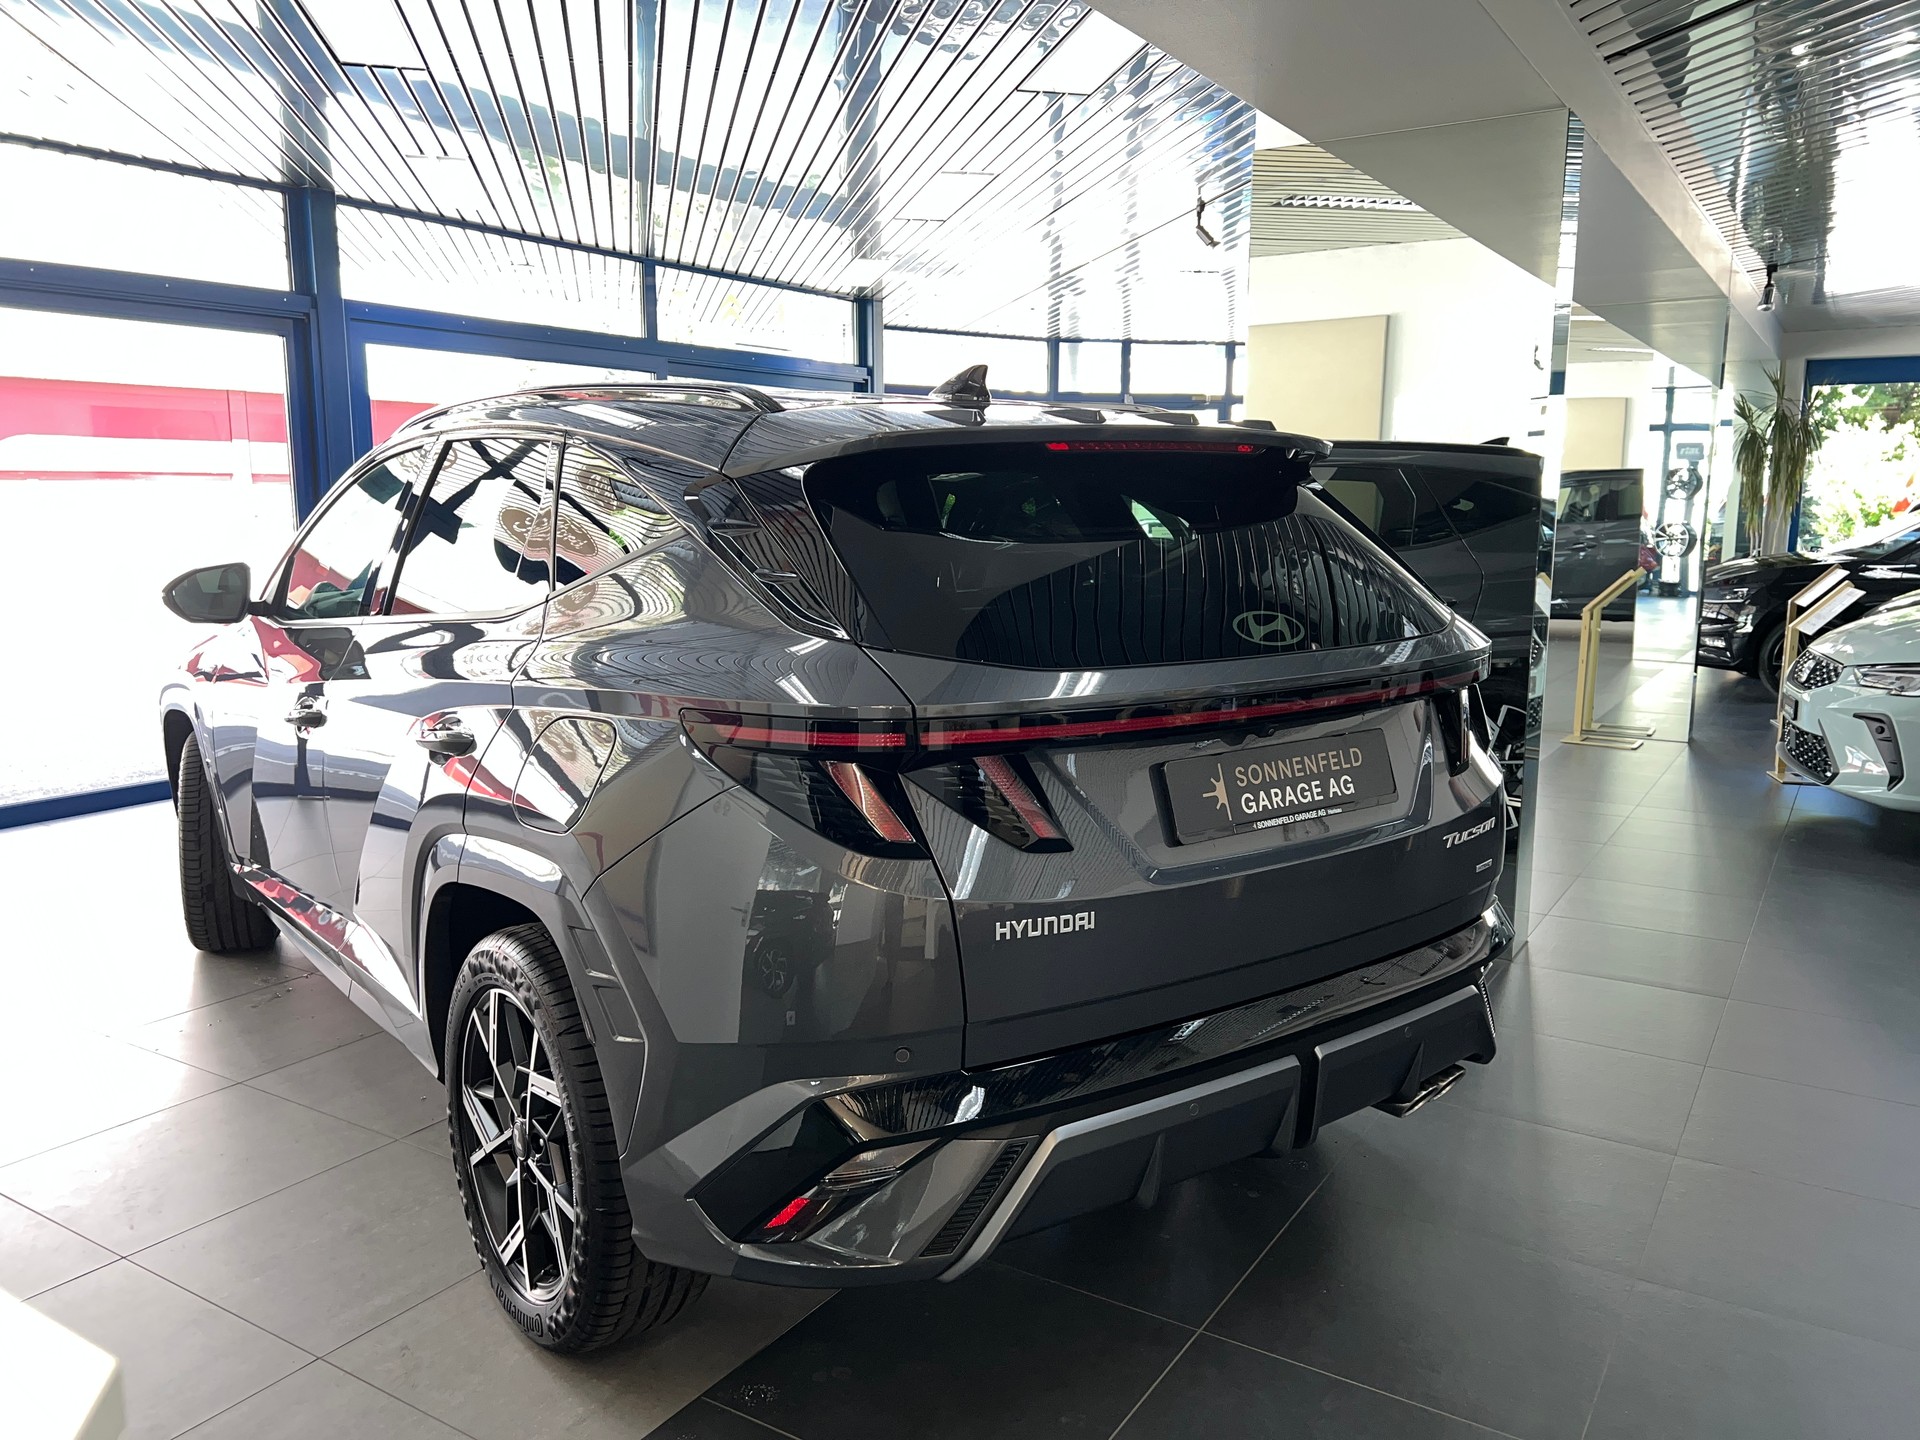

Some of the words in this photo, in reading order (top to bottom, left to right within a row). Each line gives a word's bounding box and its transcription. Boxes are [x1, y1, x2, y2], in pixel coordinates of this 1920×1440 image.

[1235, 747, 1363, 787] SONNENFELD
[1241, 779, 1324, 814] GARAGE
[1329, 775, 1355, 798] AG
[1257, 815, 1295, 829] SONNENFELD
[1294, 810, 1318, 821] GARAGE
[1317, 809, 1327, 817] AG
[995, 911, 1096, 941] HYUNDAI
[495, 1283, 544, 1338] Continental
